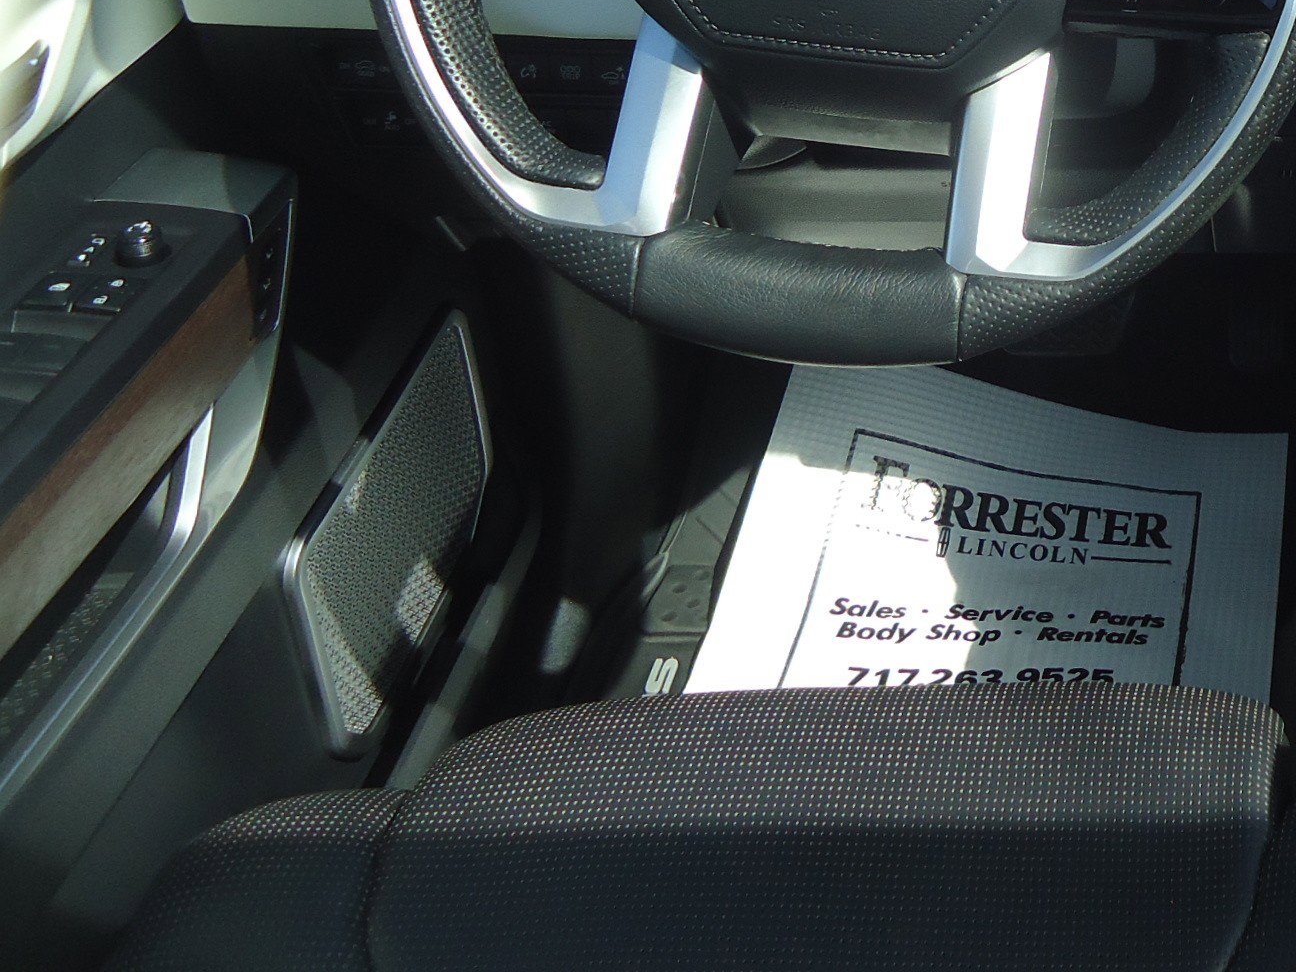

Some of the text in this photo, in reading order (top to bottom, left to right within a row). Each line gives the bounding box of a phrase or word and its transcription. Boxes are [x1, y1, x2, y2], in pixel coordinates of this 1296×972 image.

[861, 455, 1172, 548] FORRESTER
[956, 535, 1089, 565] LINCOLN
[829, 597, 1166, 628] Sales Service Parts
[835, 621, 1149, 646] Body Shop Rentals
